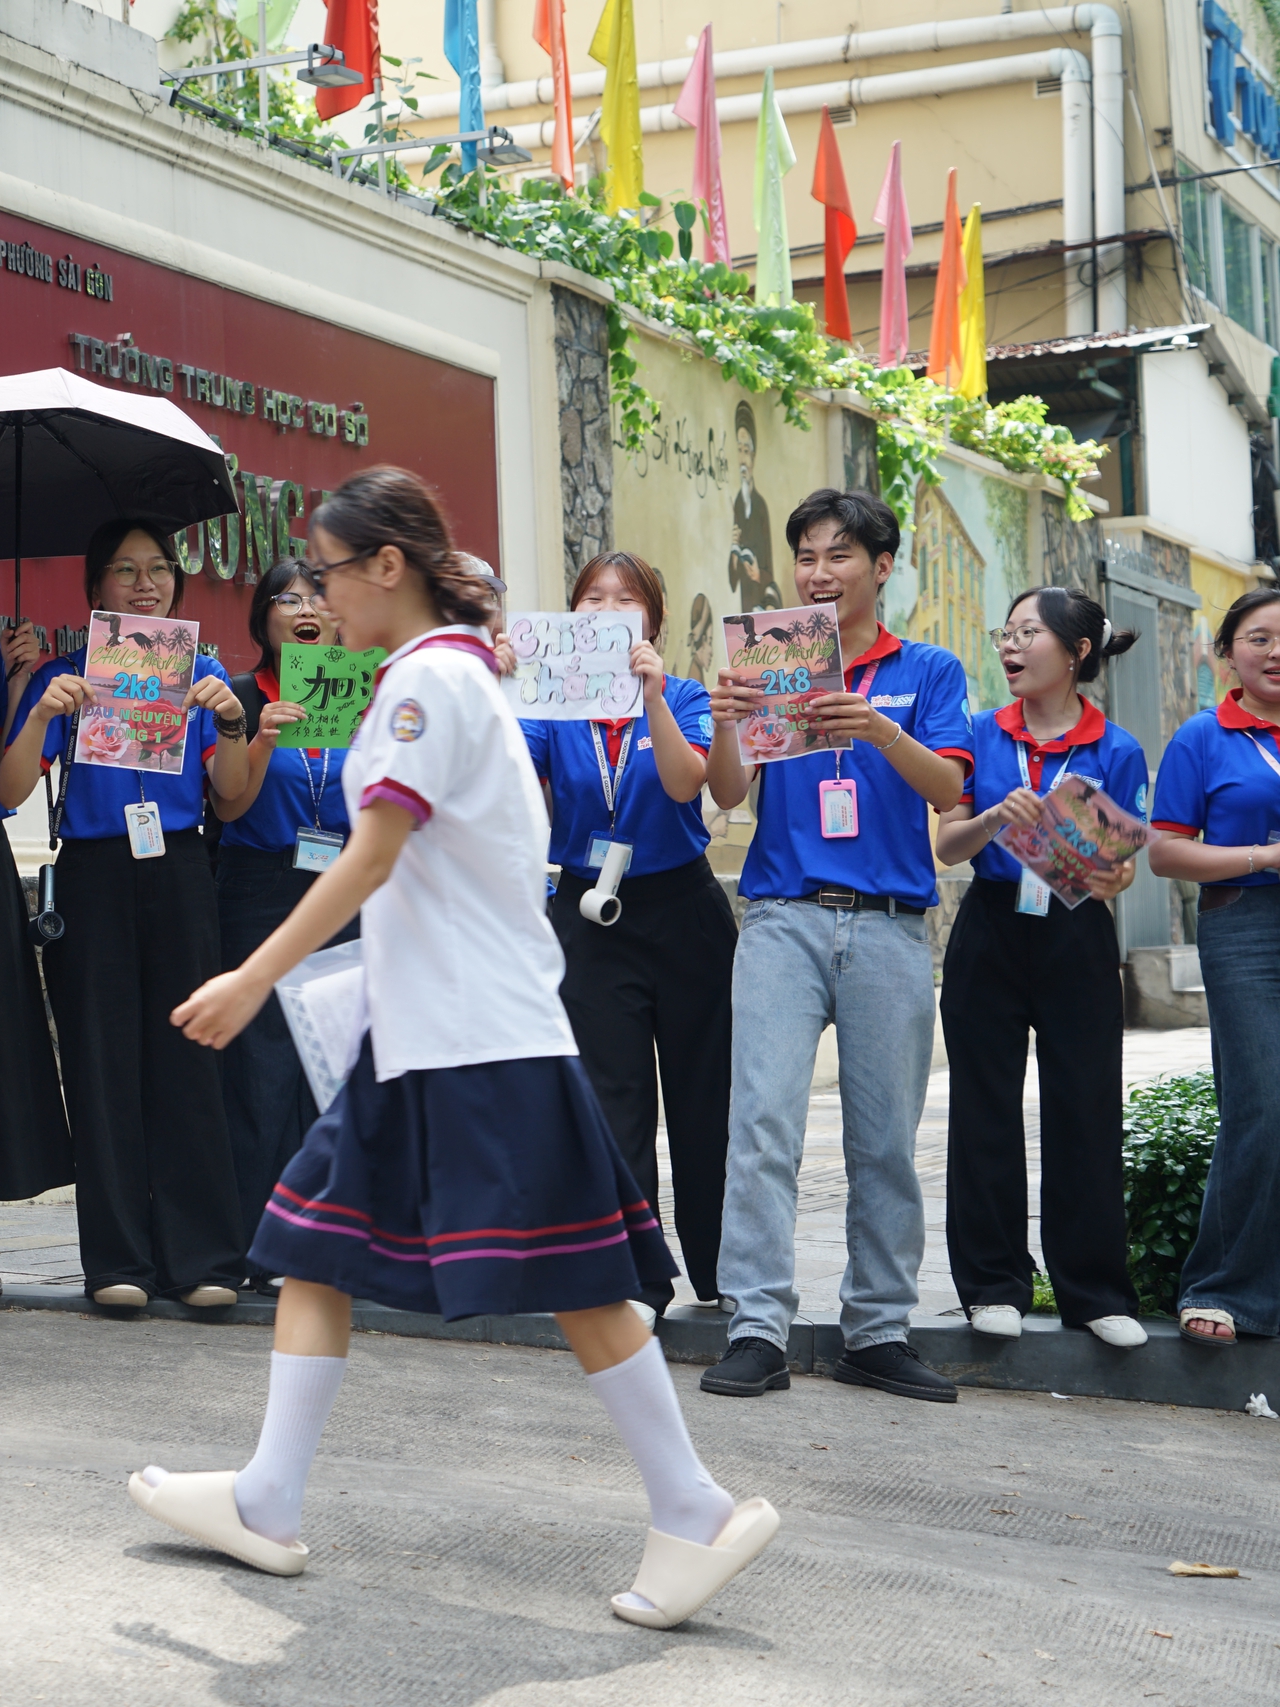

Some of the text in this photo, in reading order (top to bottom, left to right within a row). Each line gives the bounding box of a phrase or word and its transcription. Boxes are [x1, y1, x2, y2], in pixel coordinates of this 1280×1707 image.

[57, 254, 81, 292] SÀI
[84, 262, 114, 302] GÒN
[176, 363, 256, 415] TRUNG
[258, 386, 304, 434] HỌC
[90, 646, 138, 668] CHÚC
[732, 644, 781, 668] CHÚC
[113, 672, 161, 702] 2k8
[760, 667, 812, 696] 2k8
[120, 708, 182, 728] NGUYỆN
[774, 702, 810, 716] NGU
[154, 732, 162, 743] 1
